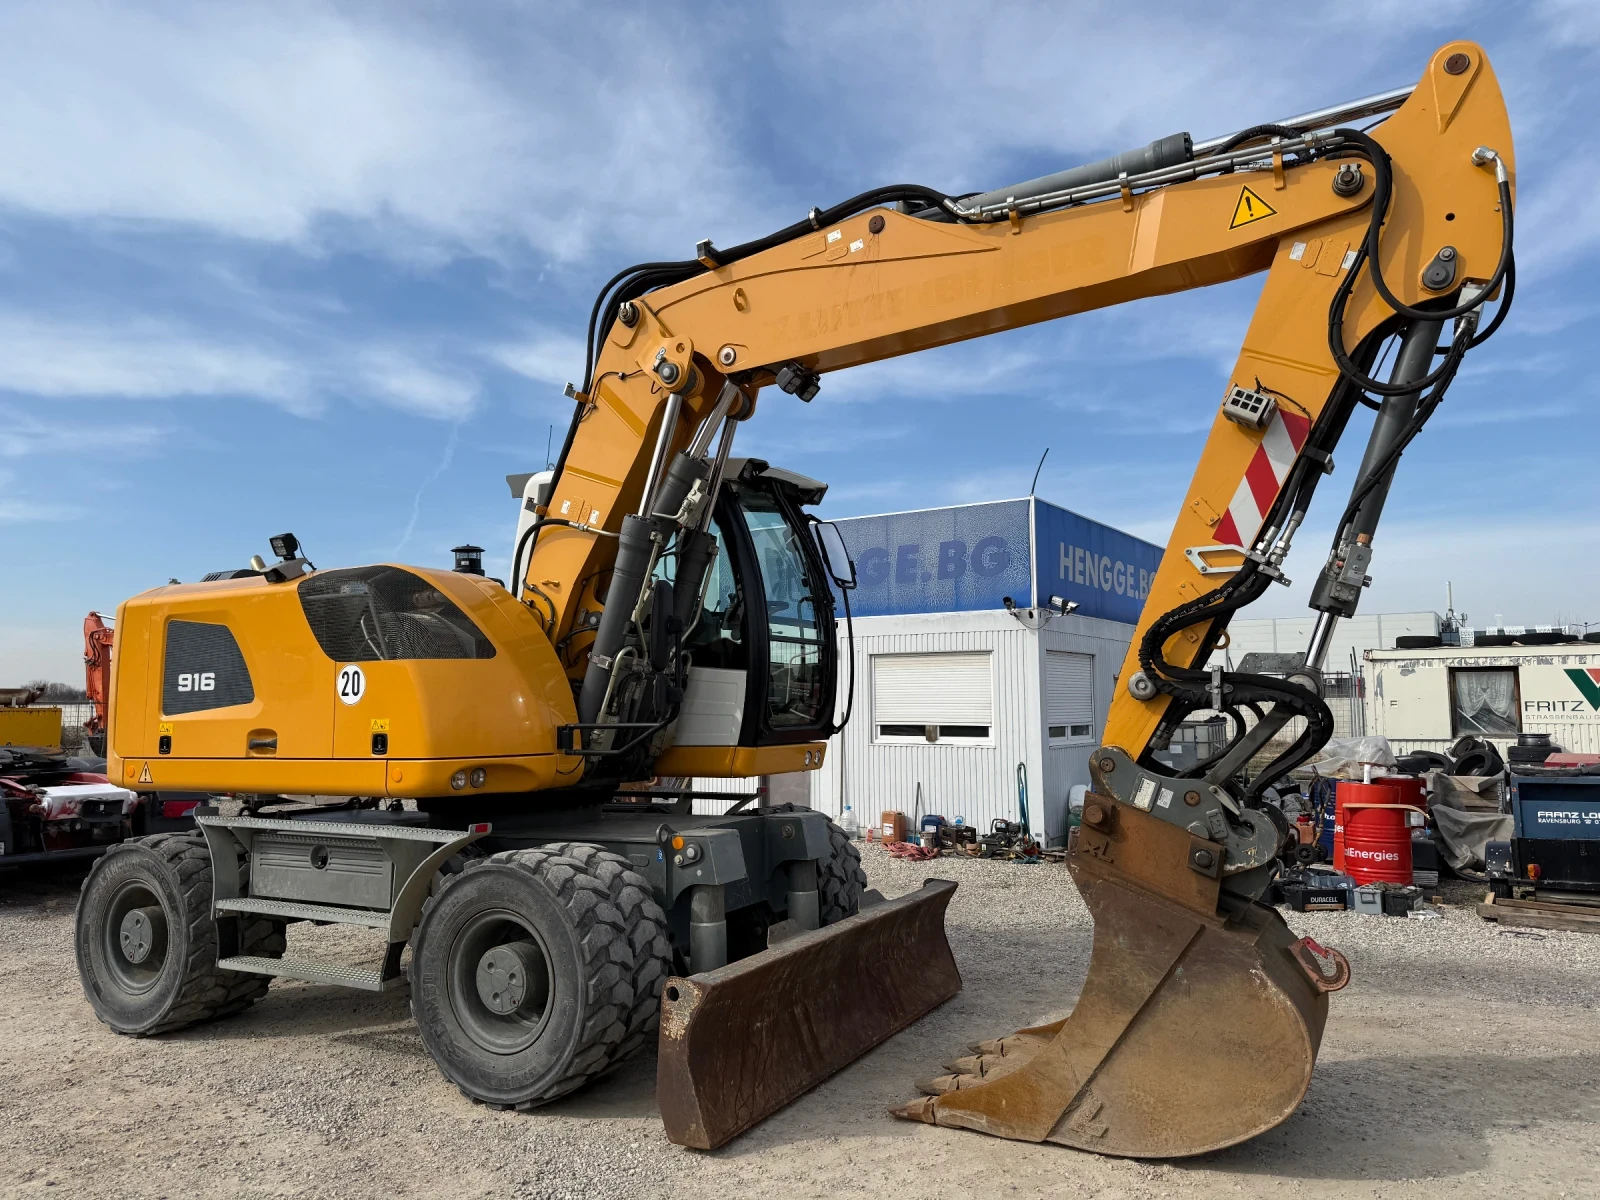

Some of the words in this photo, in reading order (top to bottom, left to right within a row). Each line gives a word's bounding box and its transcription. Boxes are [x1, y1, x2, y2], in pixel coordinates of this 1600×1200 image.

[177, 672, 215, 692] 916
[341, 670, 361, 697] 20
[1524, 700, 1585, 712] FRITZ
[1537, 811, 1580, 819] FRANZ
